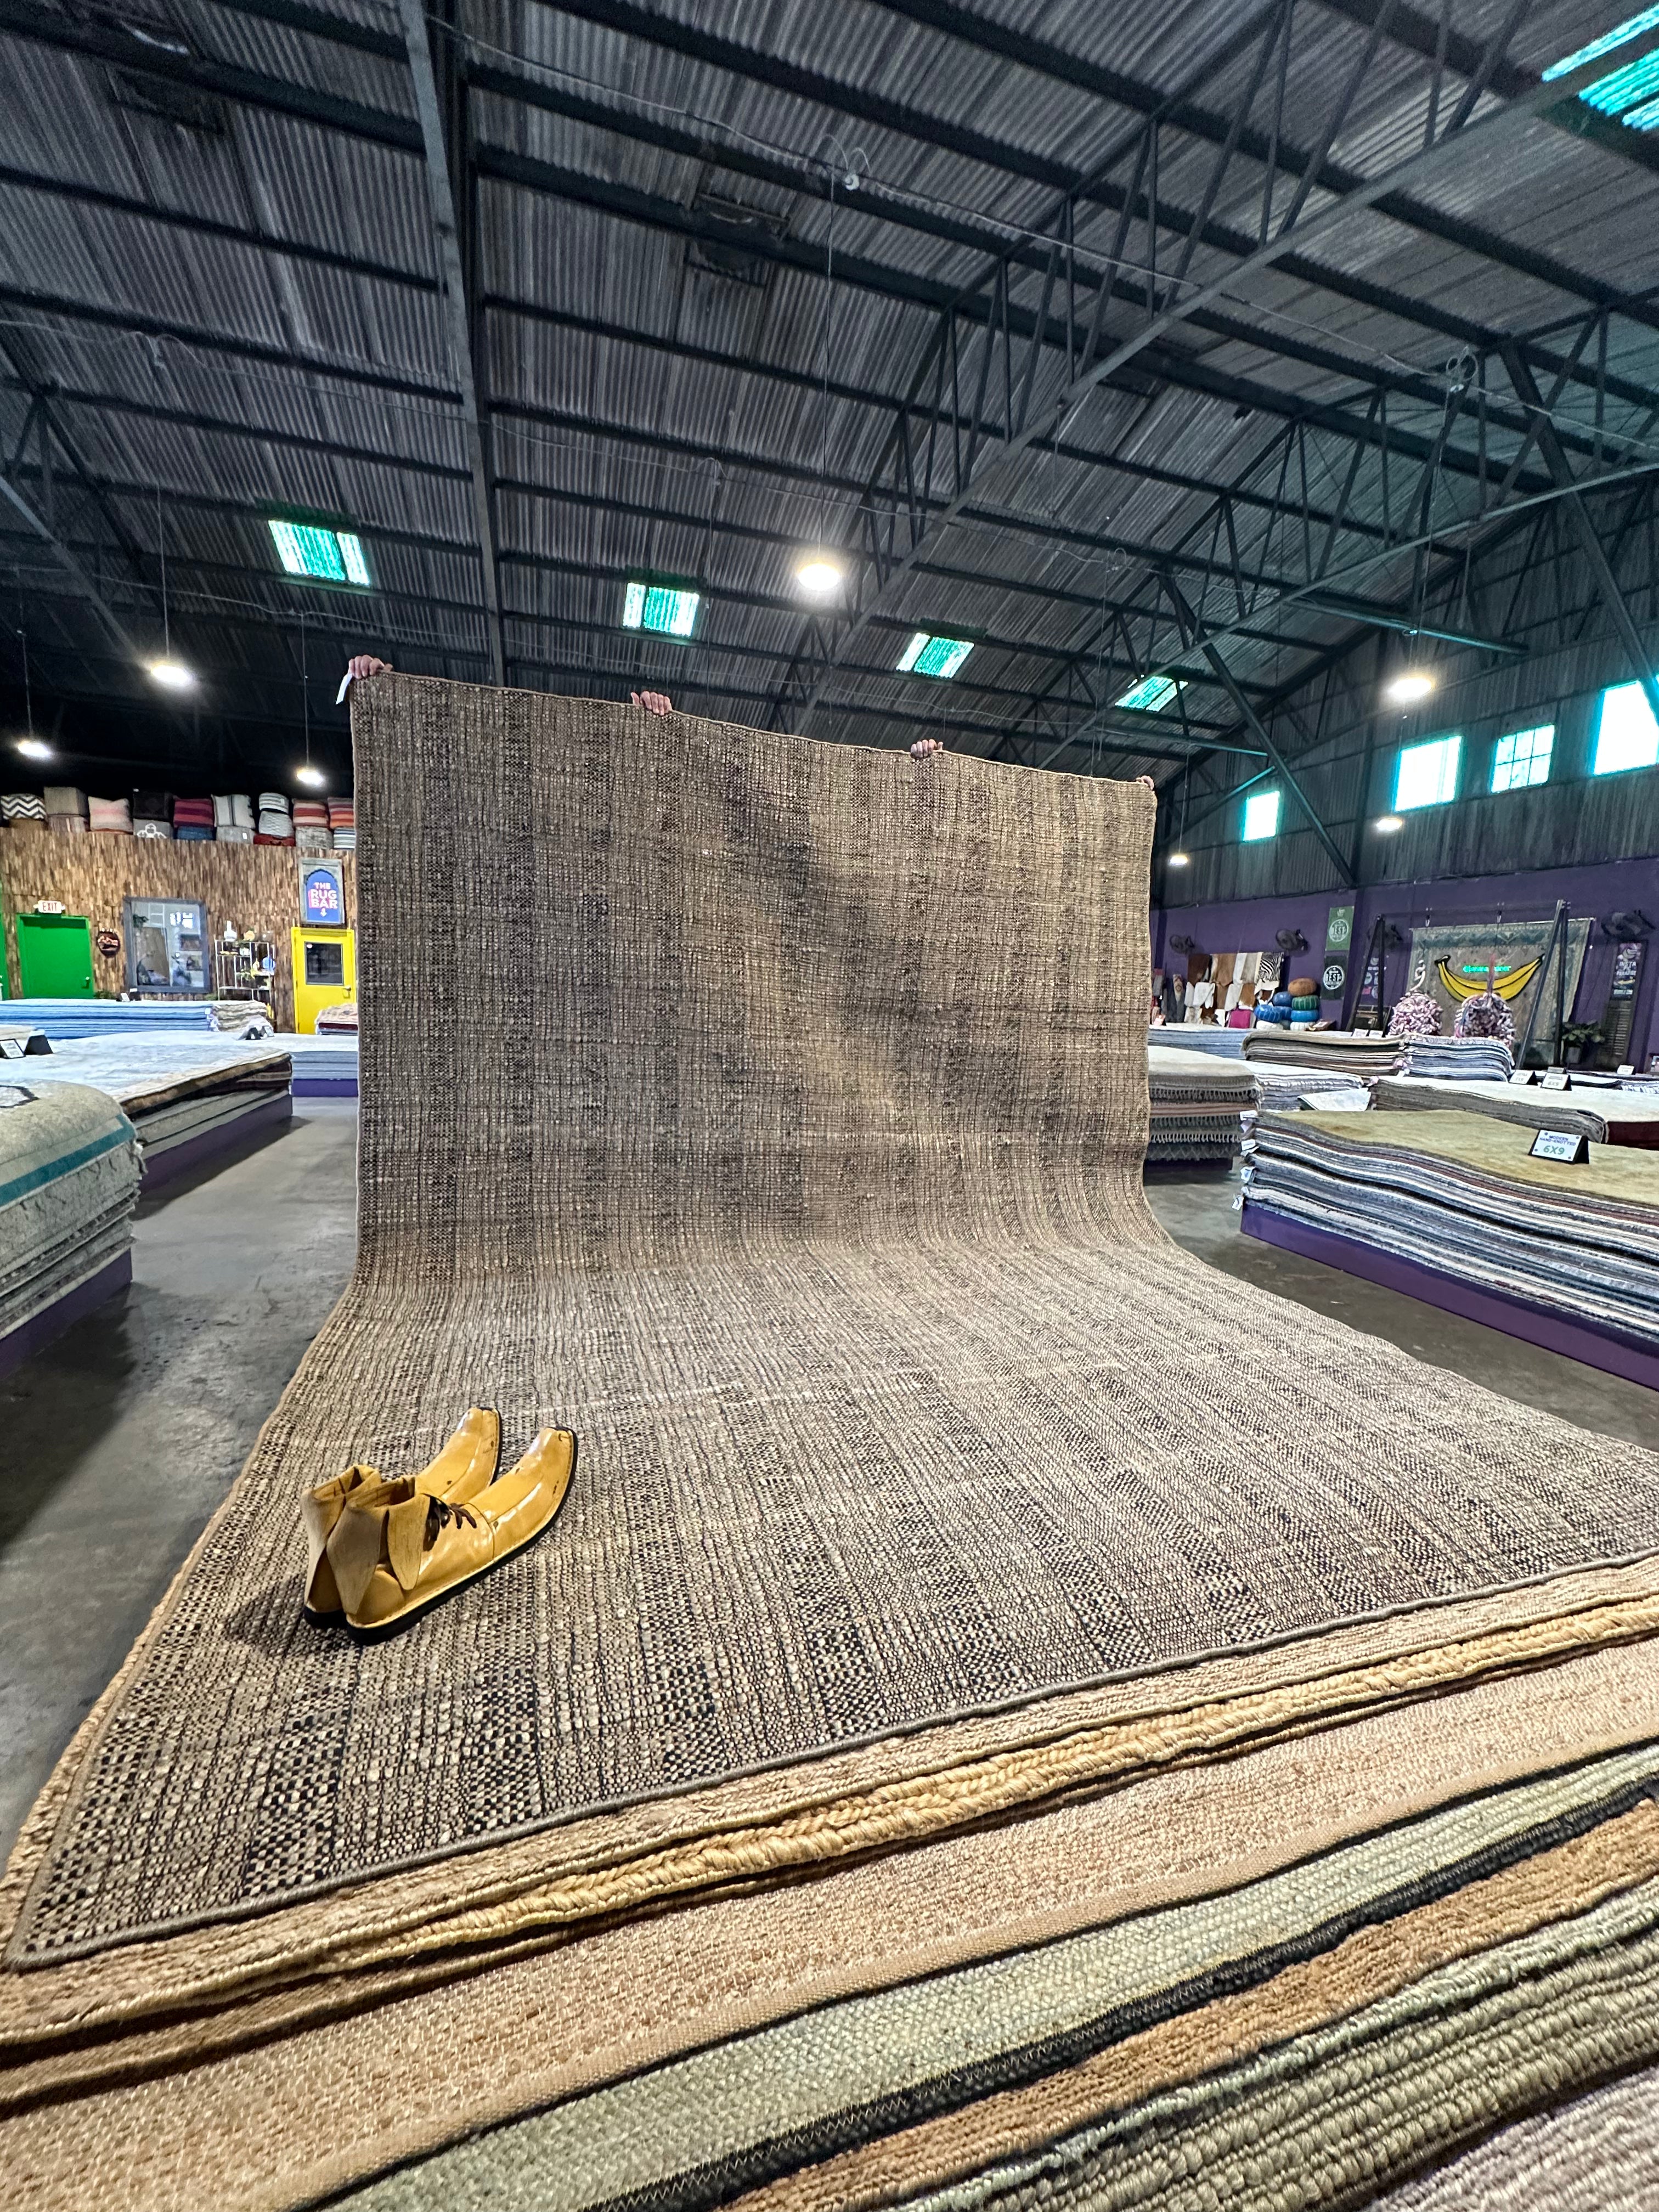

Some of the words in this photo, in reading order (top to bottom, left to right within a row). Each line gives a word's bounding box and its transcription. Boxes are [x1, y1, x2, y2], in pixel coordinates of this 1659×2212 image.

[310, 889, 337, 900] RUG
[42, 901, 57, 911] EXIT
[311, 899, 338, 909] BAR
[1539, 1137, 1577, 1146] HAND-KNOTTED
[1543, 1145, 1565, 1155] 6X9
